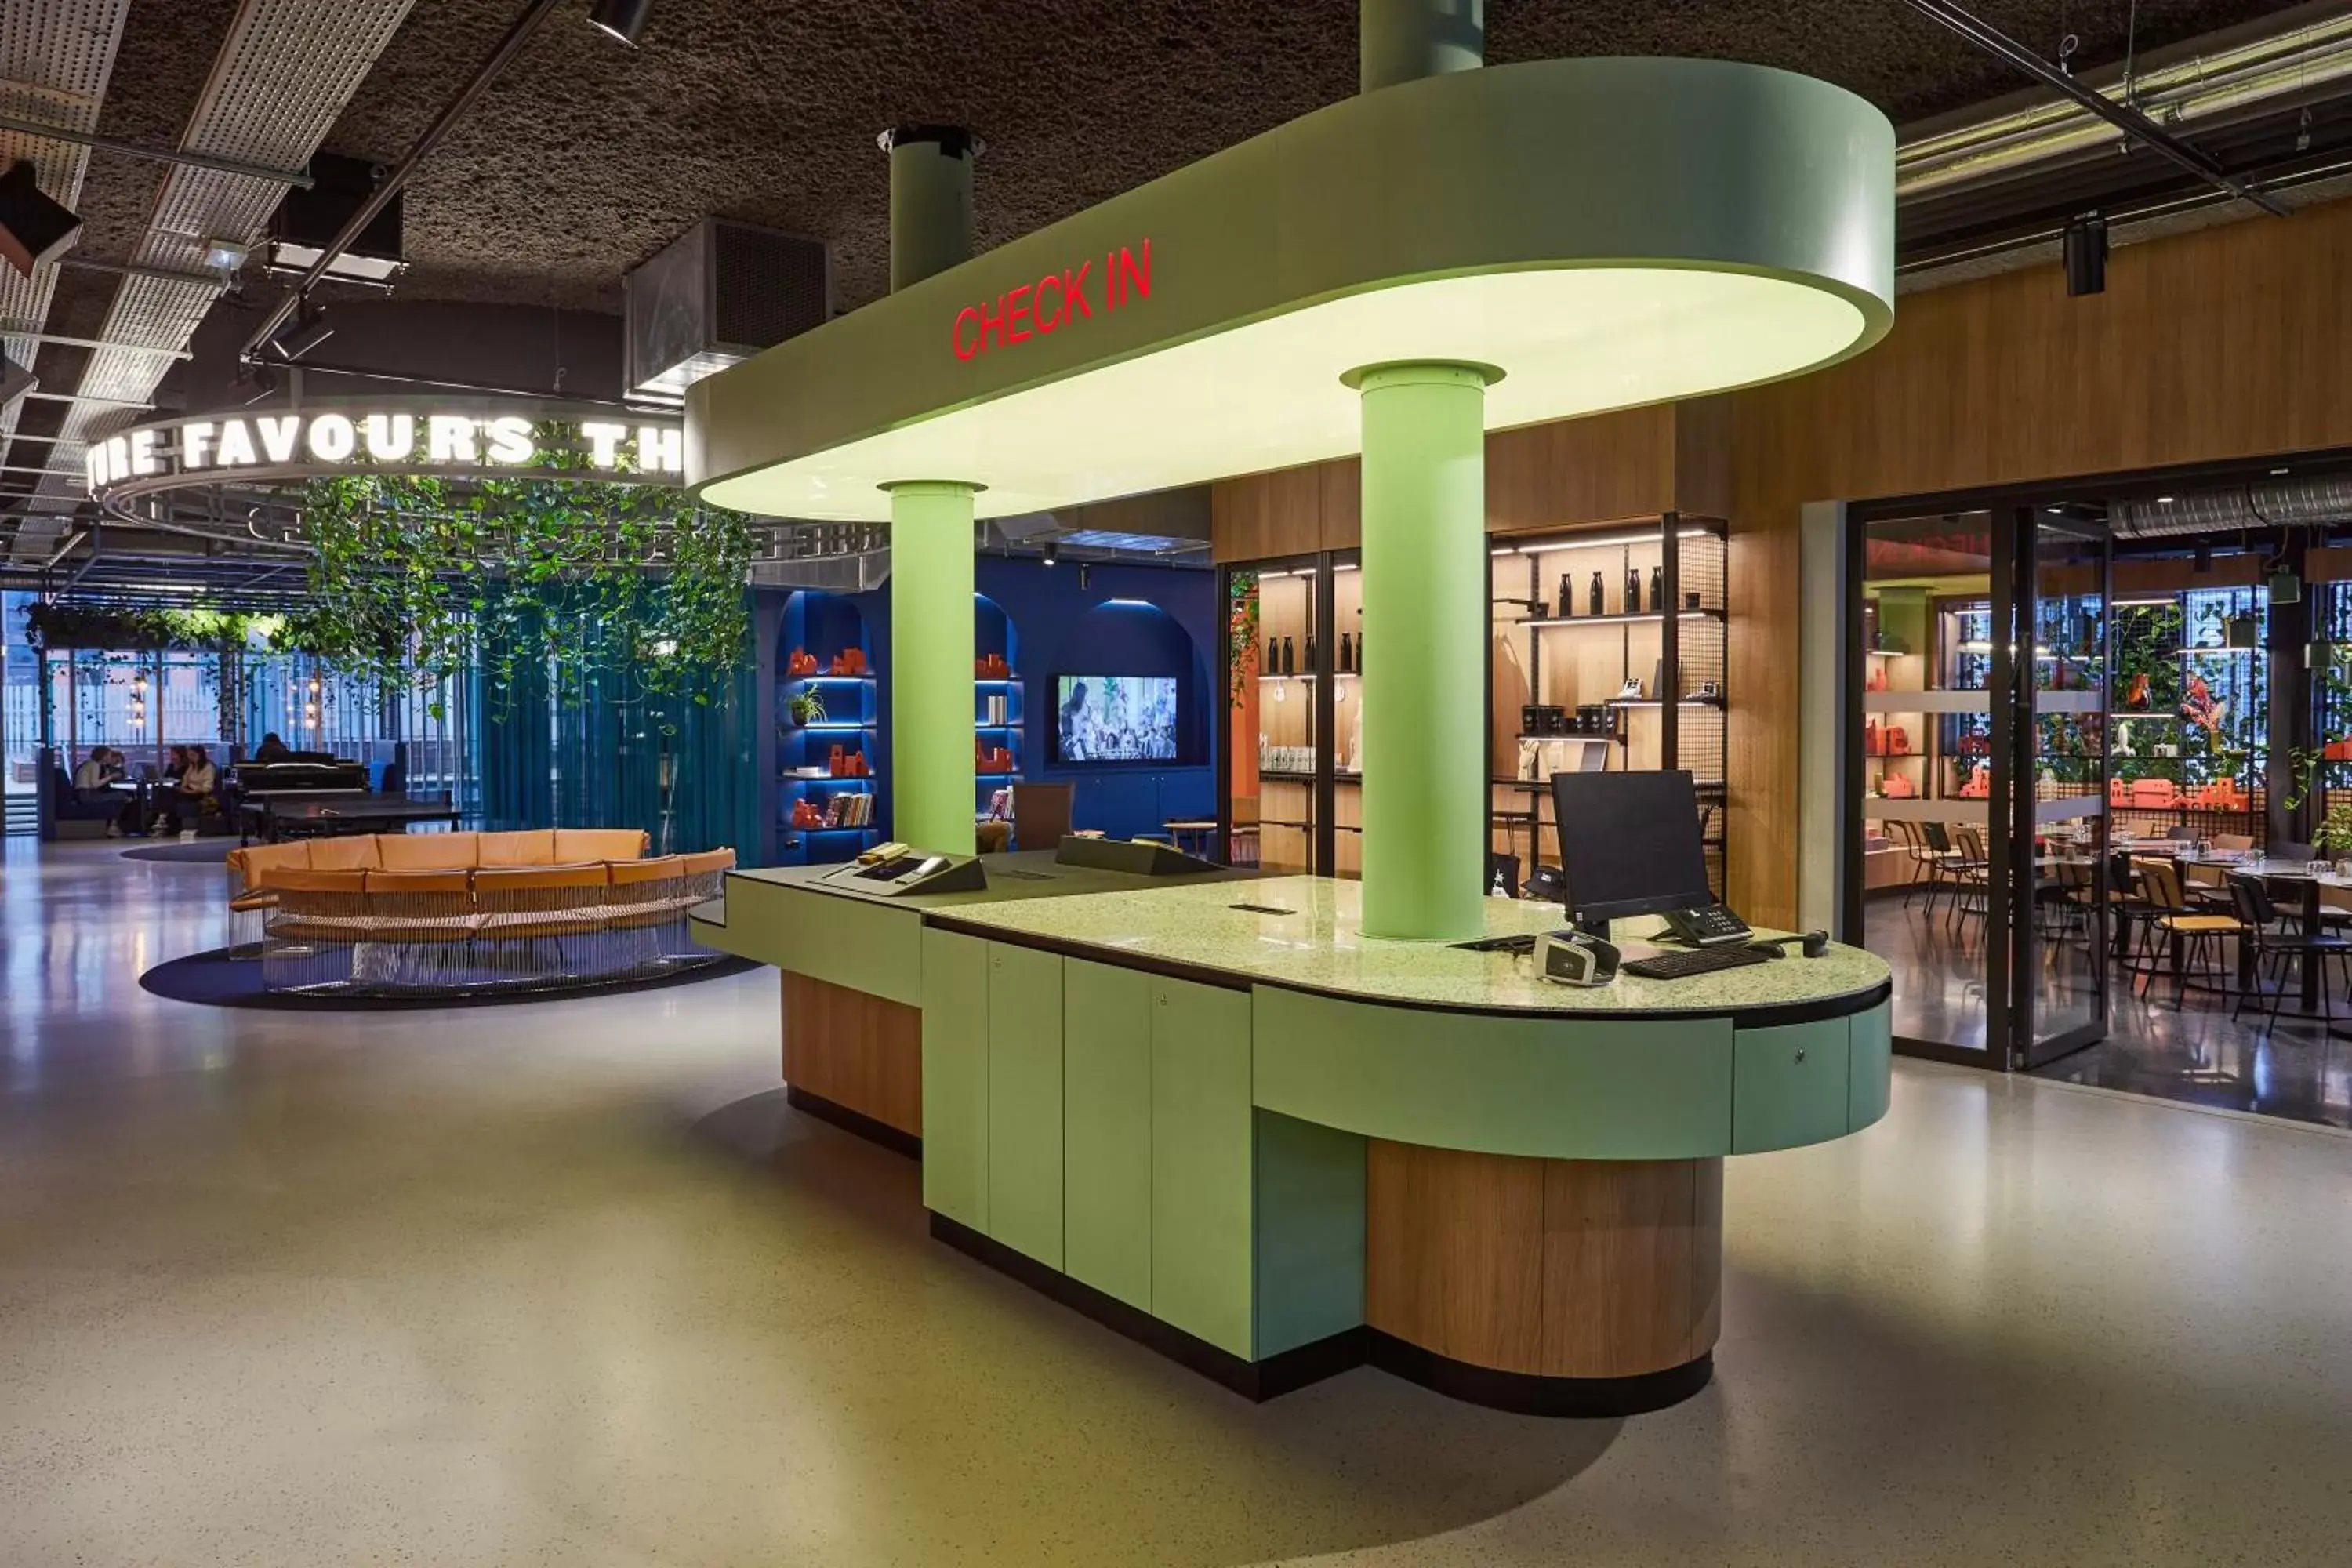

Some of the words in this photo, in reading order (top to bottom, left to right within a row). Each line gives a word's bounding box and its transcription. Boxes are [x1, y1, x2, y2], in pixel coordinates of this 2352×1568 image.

[953, 261, 1092, 361] CHECK
[1106, 236, 1151, 312] IN
[183, 413, 534, 467] FAVOURS
